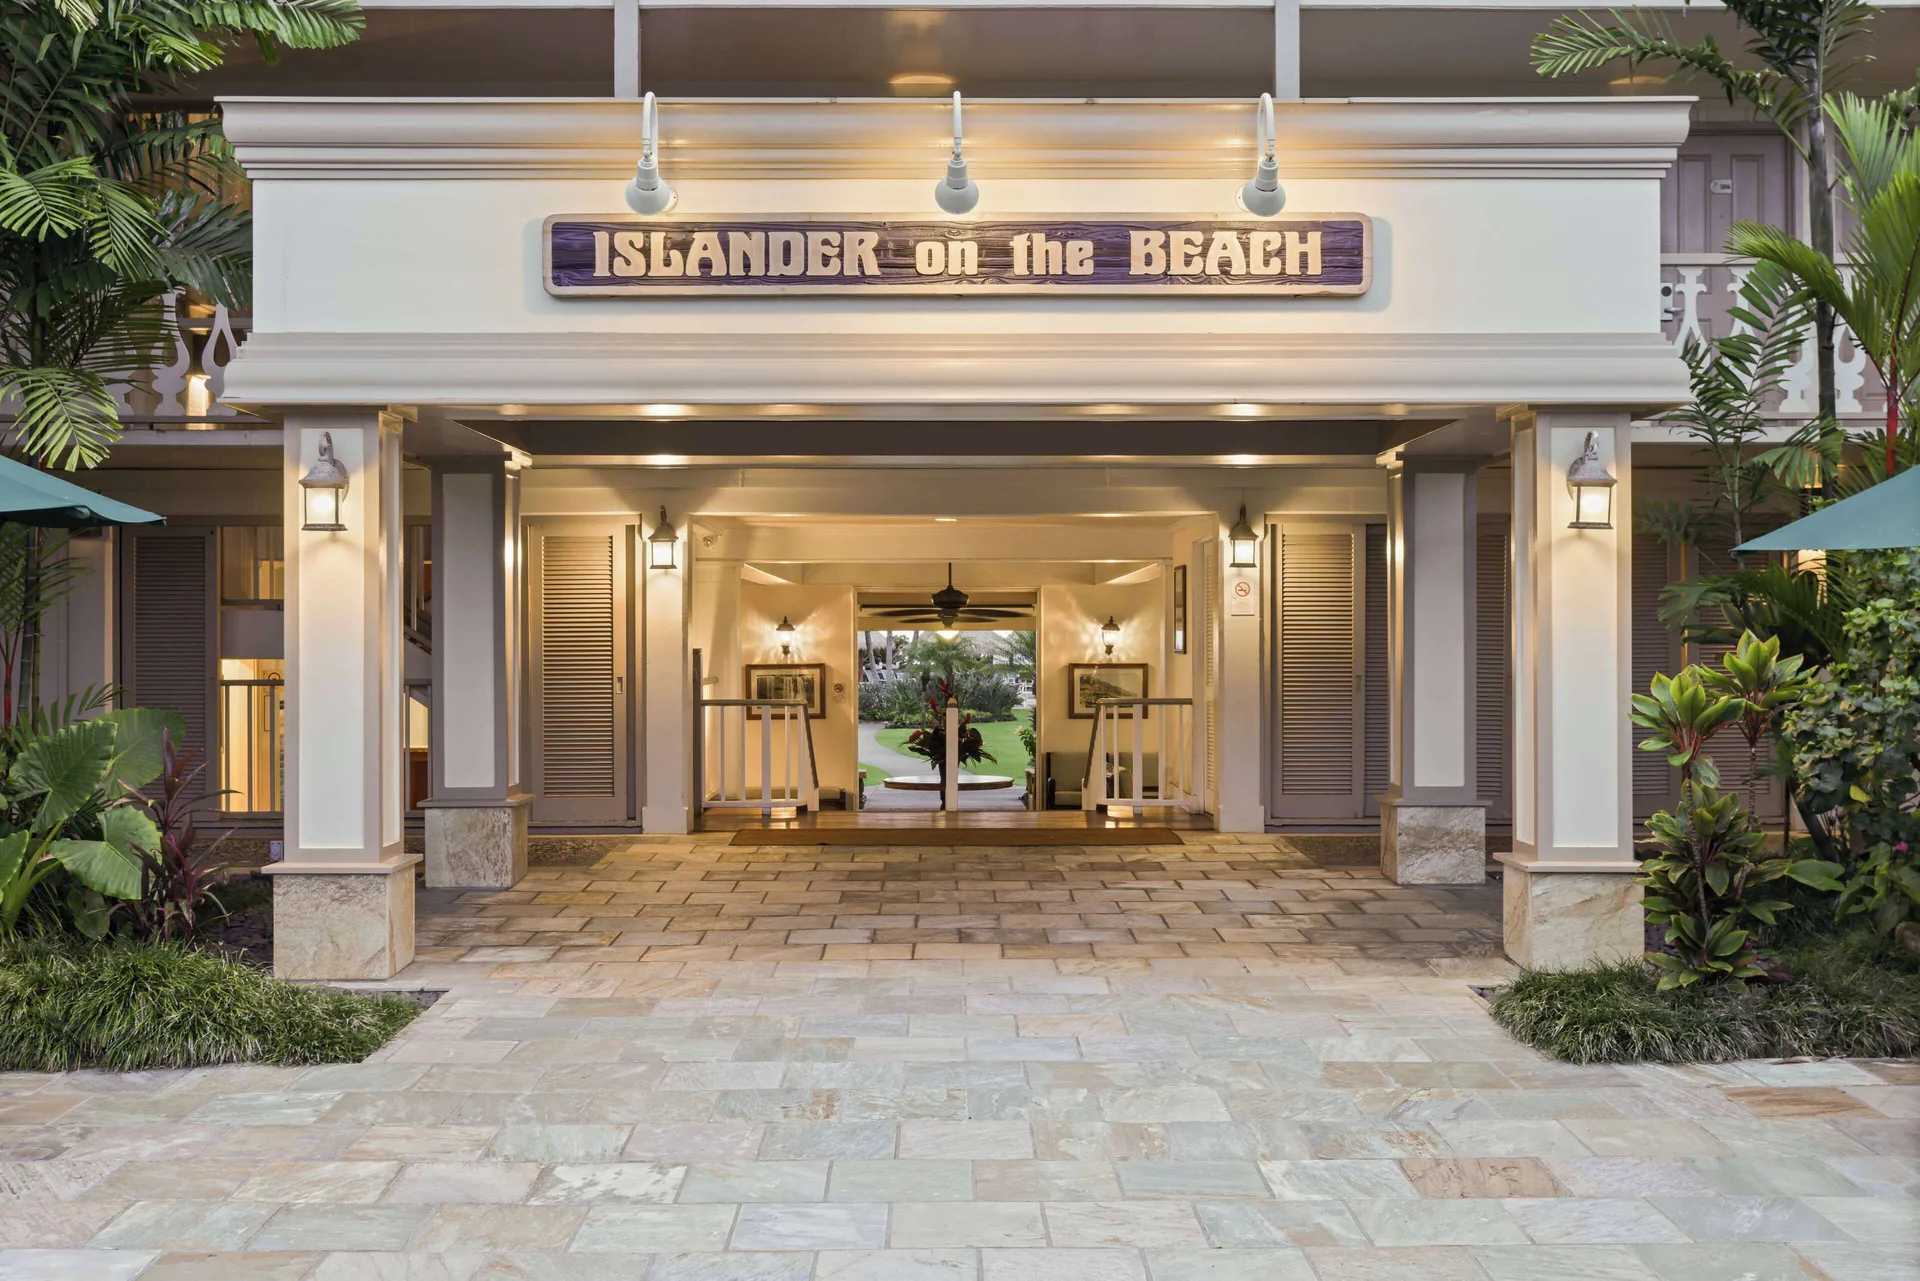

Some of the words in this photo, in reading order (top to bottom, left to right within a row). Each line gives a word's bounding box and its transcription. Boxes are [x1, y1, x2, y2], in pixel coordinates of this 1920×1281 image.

[593, 231, 882, 277] ISLANDER
[915, 240, 978, 276] on
[1010, 232, 1095, 276] the
[1128, 230, 1322, 275] BEACH
